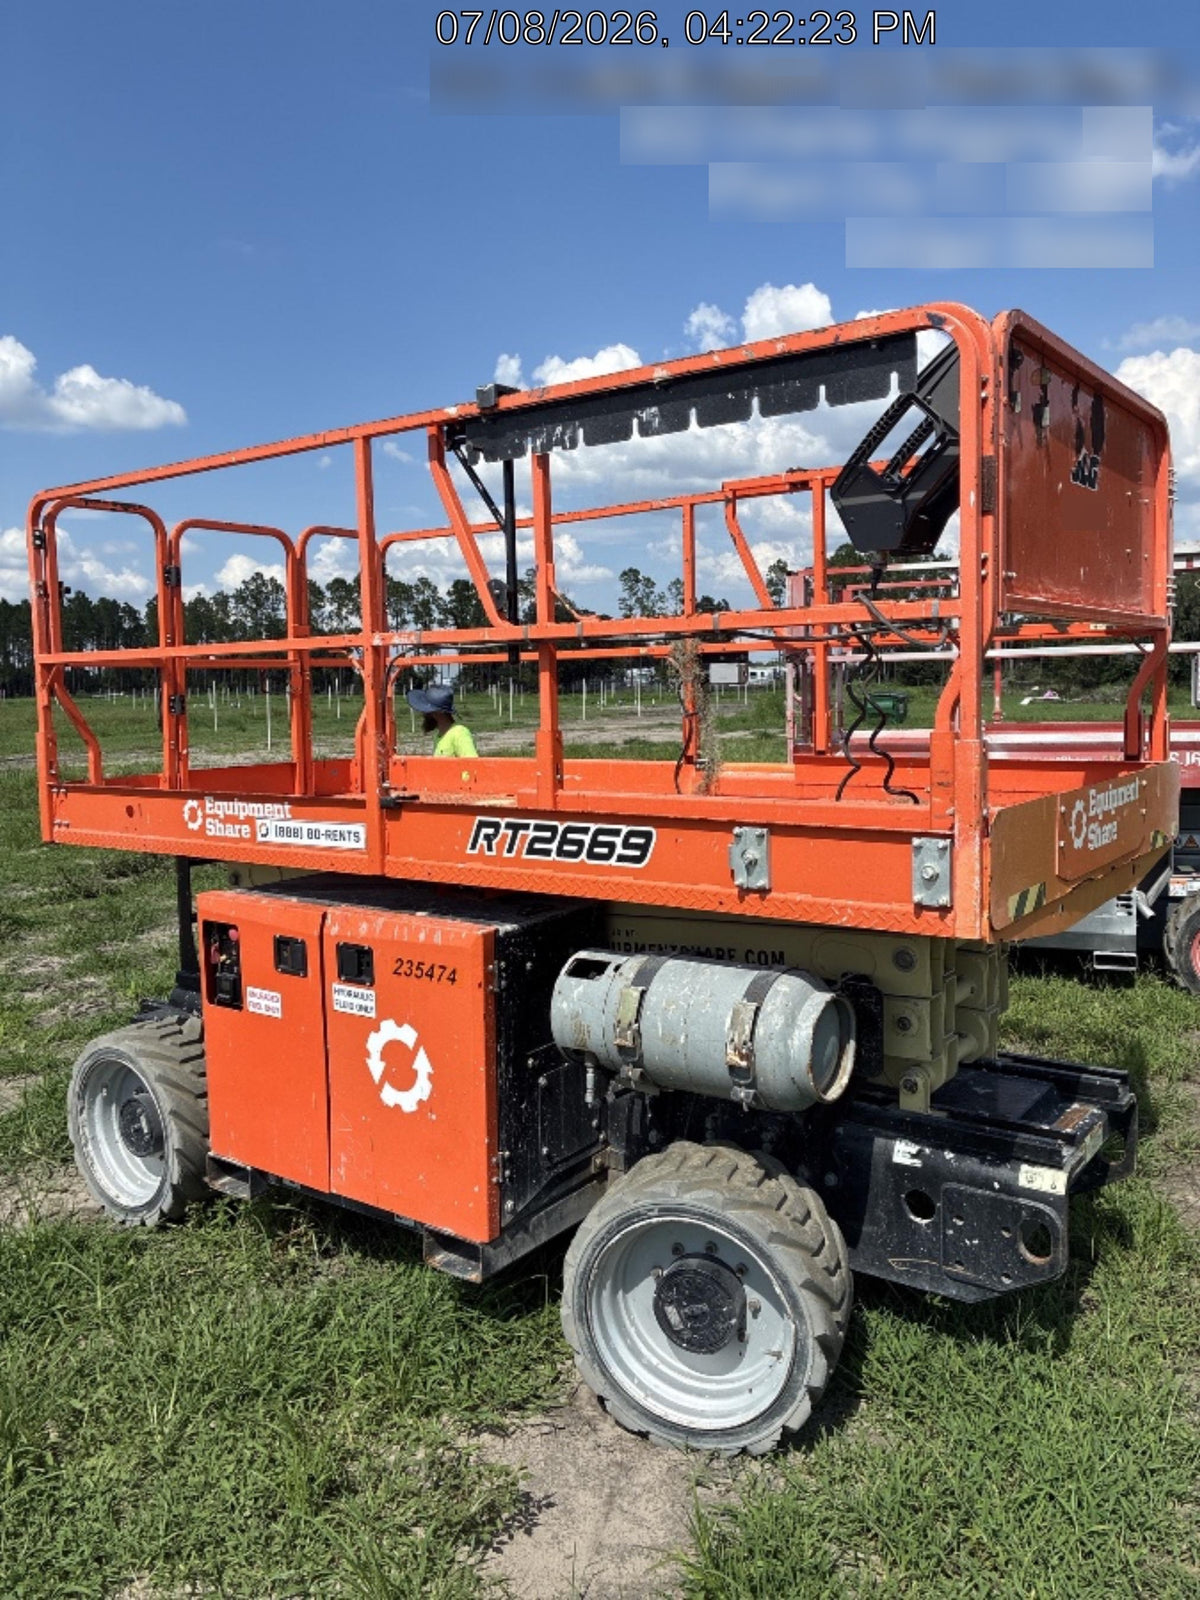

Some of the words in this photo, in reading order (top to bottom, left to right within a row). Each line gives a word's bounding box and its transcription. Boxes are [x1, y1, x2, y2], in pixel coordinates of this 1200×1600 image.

[204, 796, 292, 819] Equipment
[1088, 776, 1139, 820] Equipment
[205, 817, 251, 838] Share
[274, 825, 304, 840] (888)
[307, 828, 362, 844] 80-RENTS
[467, 816, 656, 868] RT2669
[1087, 820, 1118, 851] Share
[392, 957, 457, 986] 235474
